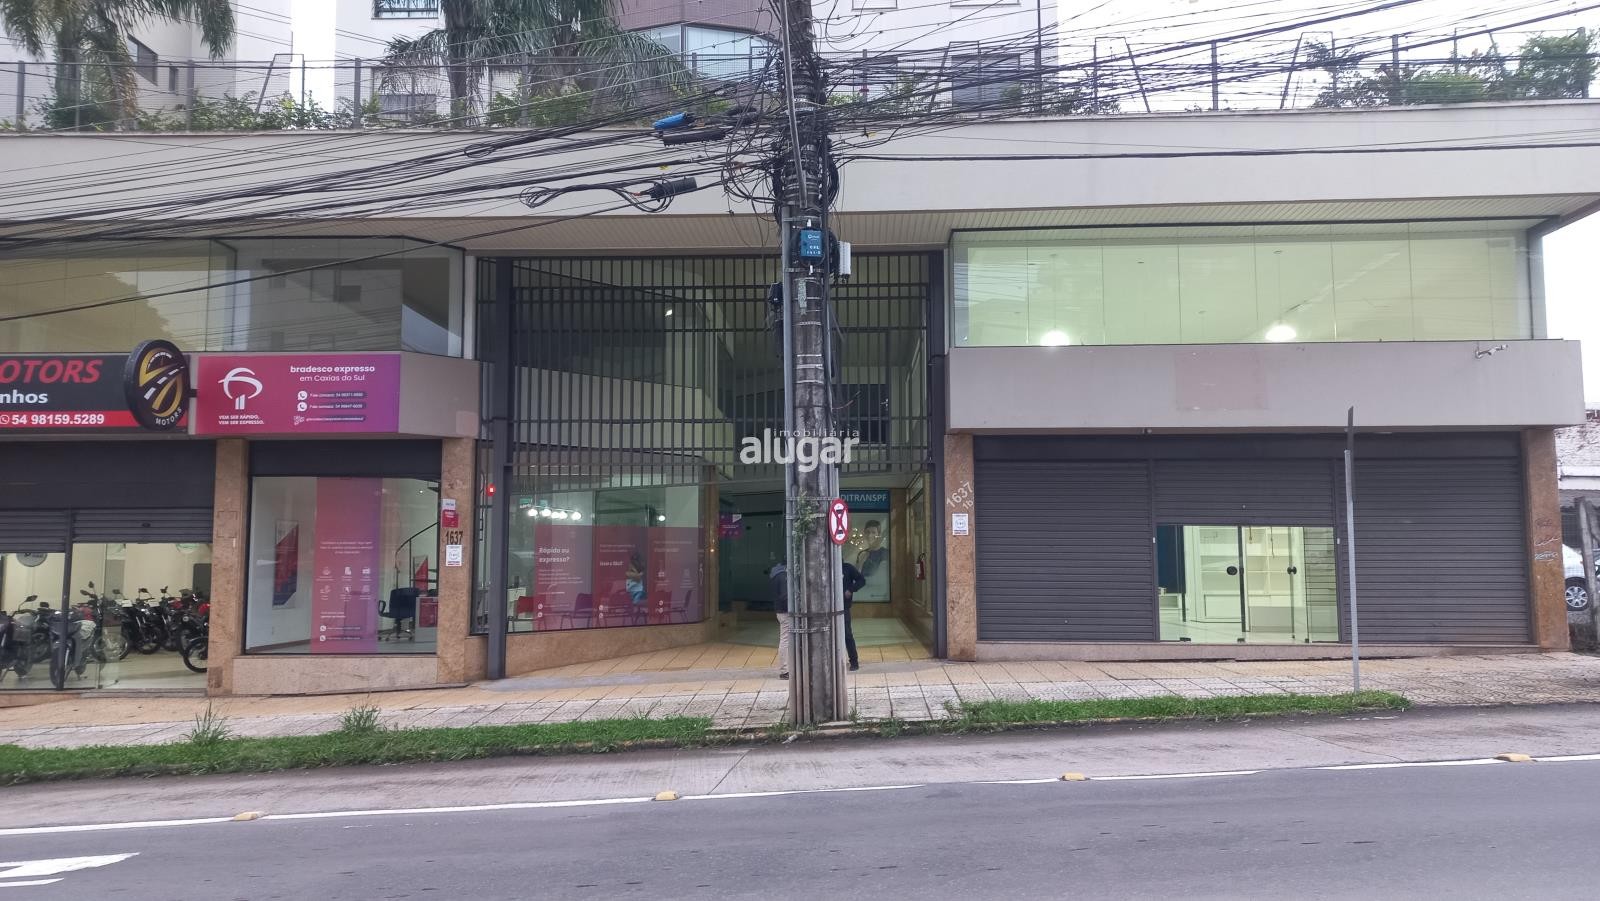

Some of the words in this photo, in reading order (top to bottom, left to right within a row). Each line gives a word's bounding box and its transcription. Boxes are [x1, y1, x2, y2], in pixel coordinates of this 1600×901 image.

[290, 365, 333, 373] bradesco
[334, 366, 376, 374] expresso
[0, 389, 48, 404] nhos
[11, 415, 28, 425] 54
[31, 414, 105, 425] 98159.5289
[154, 406, 182, 426] MOTORS
[946, 481, 973, 508] 1637
[445, 530, 463, 545] 1637
